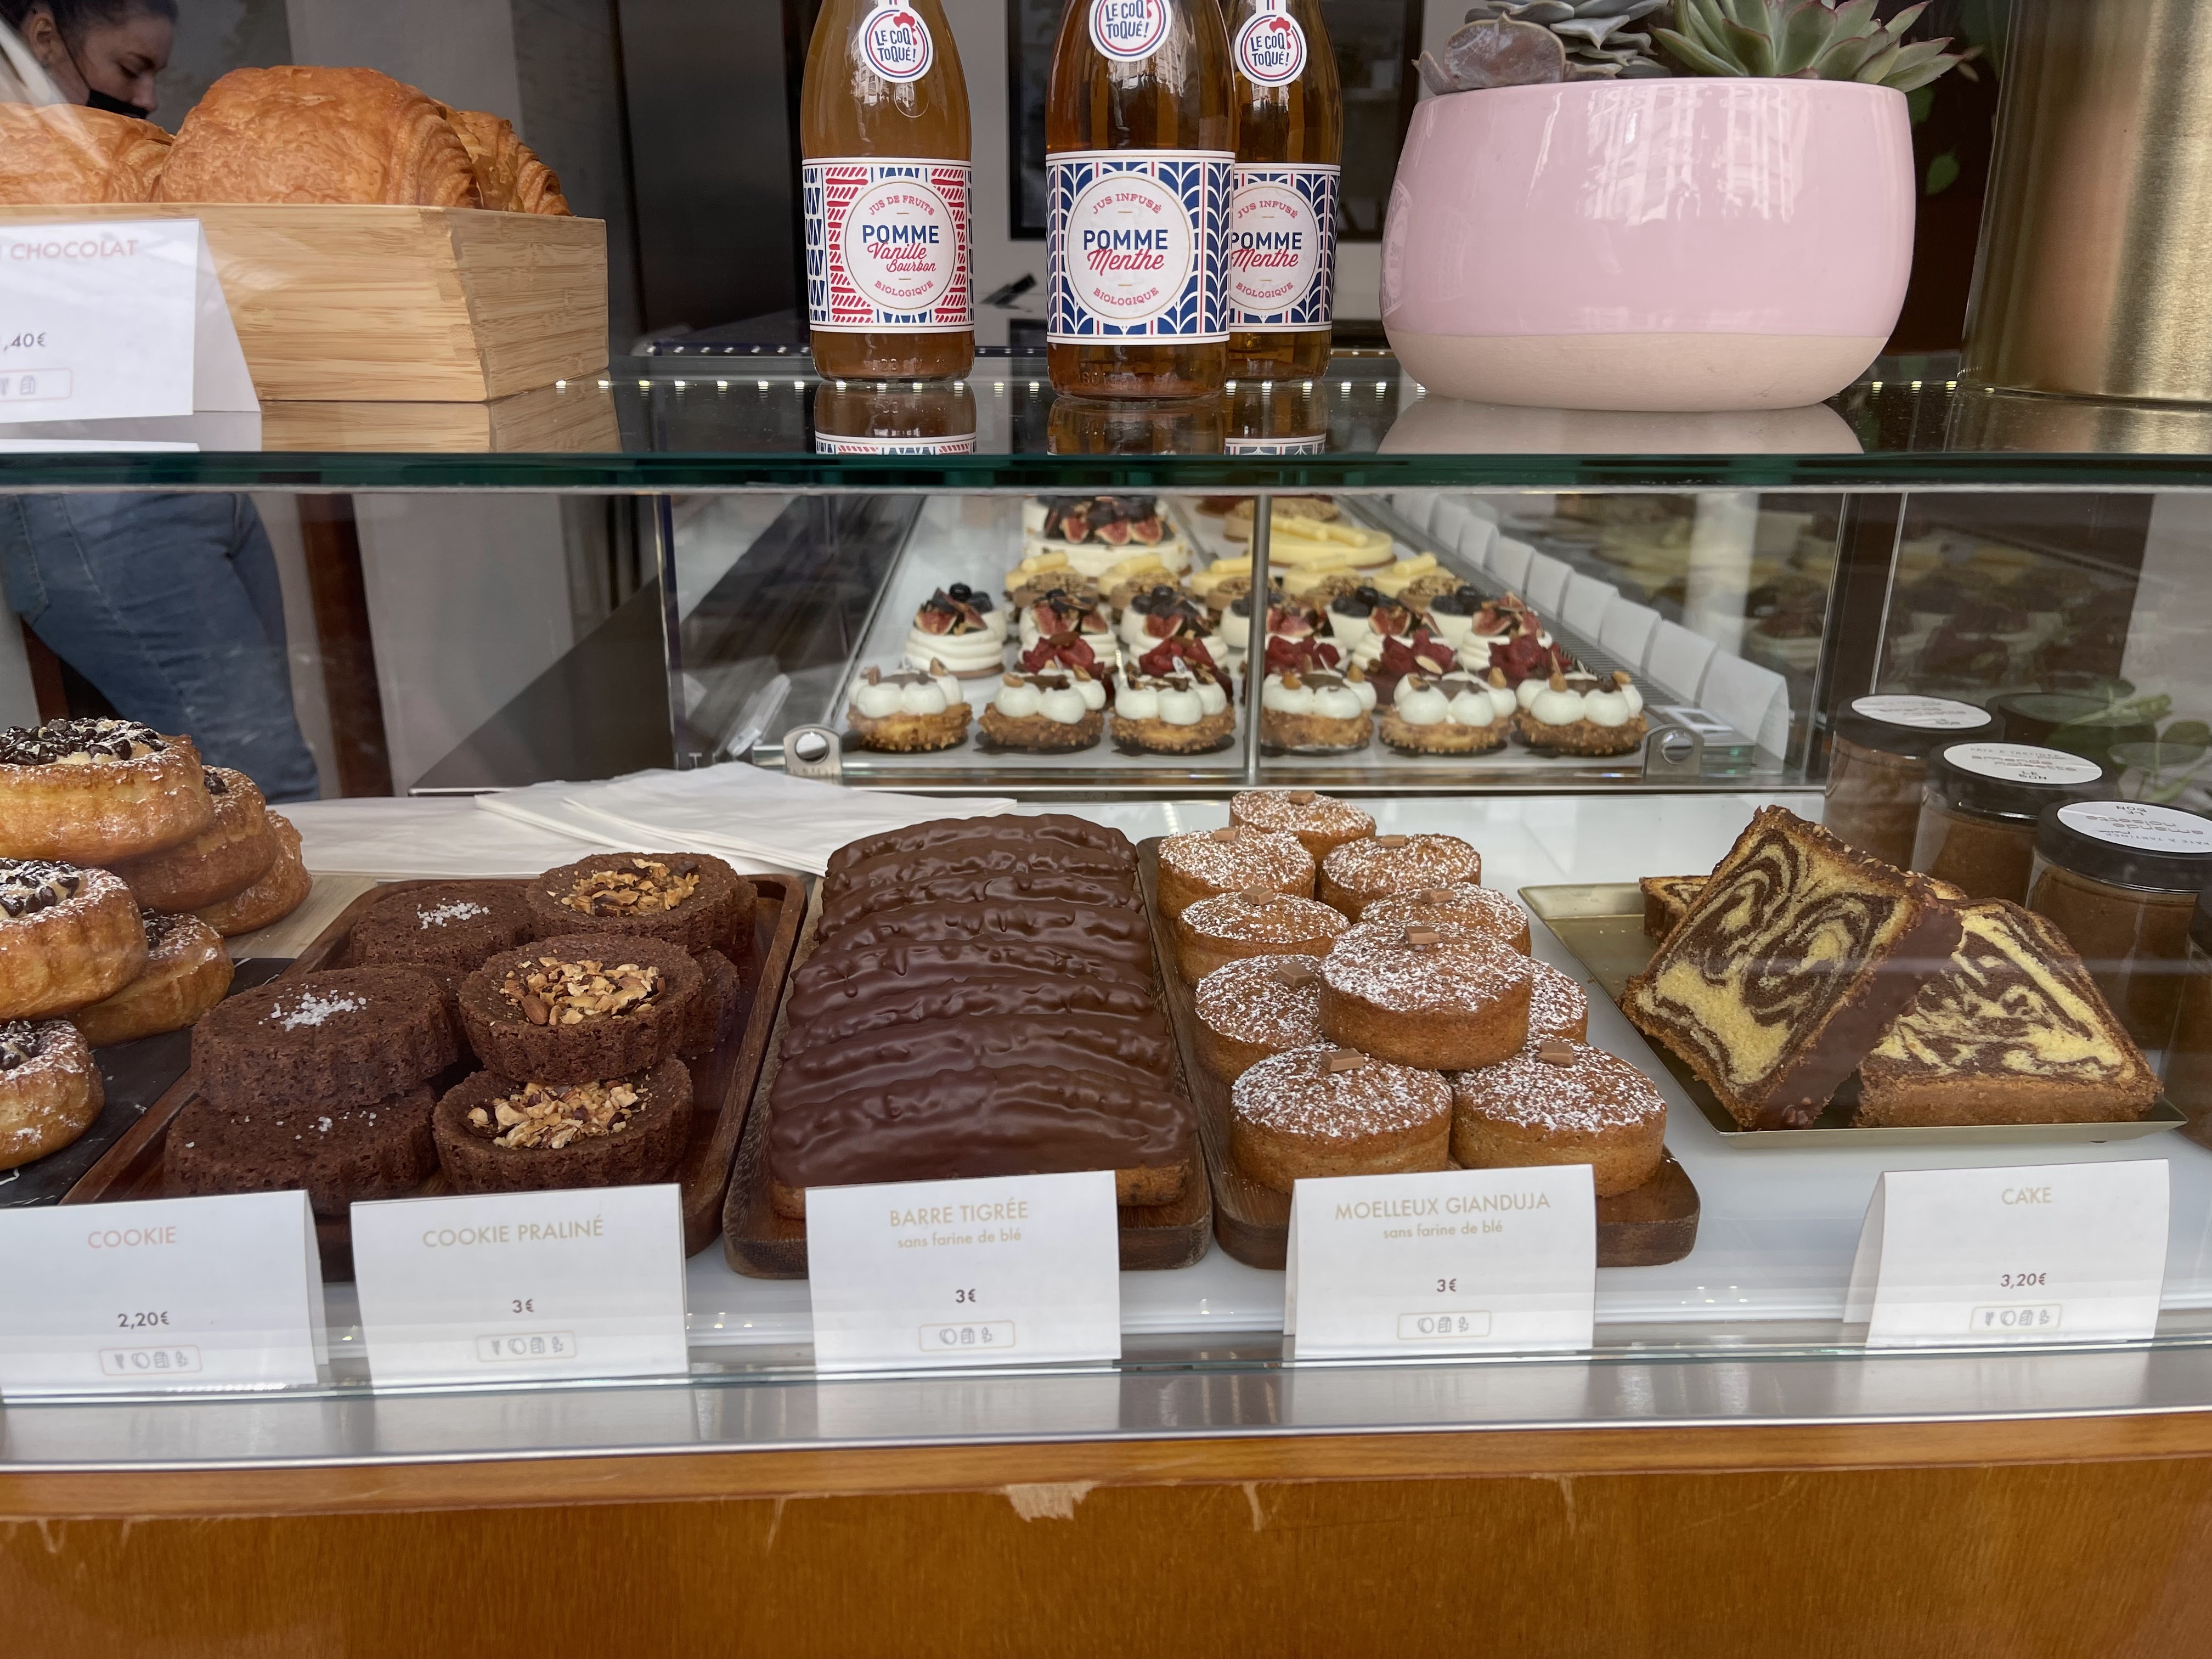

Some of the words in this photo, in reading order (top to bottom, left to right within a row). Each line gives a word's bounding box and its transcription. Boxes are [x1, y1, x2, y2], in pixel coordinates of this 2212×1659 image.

[1105, 3, 1118, 21] LE
[1121, 0, 1144, 19] COQ
[874, 30, 887, 46] LE
[890, 27, 911, 46] COQ
[1250, 36, 1262, 52] LE
[1265, 32, 1285, 49] COQ
[868, 200, 885, 215] JUS
[888, 195, 899, 205] DE
[902, 195, 935, 216] FRUITS
[1092, 195, 1113, 215] JUS
[1116, 193, 1163, 215] INFUSÉ
[1237, 202, 1256, 219] JUS
[1260, 200, 1298, 219] INFUSÉ
[862, 224, 939, 244] POMME
[1084, 229, 1169, 251] POMME
[1232, 232, 1302, 250] POMME
[10, 239, 138, 261] CHOCOLAT
[867, 241, 927, 259] Vanille
[886, 259, 936, 272] Bourbon
[1087, 249, 1164, 276] Menthe
[1231, 249, 1299, 272] Menthe
[874, 280, 934, 297] BIOLOGIQUE
[1092, 287, 1159, 306] BIOLOGIQUE
[1235, 282, 1294, 298] BIOLOGIQUE
[1, 332, 47, 352] ,40€
[2086, 816, 2177, 827] noisette
[2113, 823, 2204, 835] amande
[2106, 833, 2163, 842] TARTINER
[2001, 1187, 2052, 1205] CAKE
[889, 1206, 953, 1227] BARRE
[960, 1198, 1029, 1222] TIGRÉE
[1335, 1198, 1440, 1220] MOELLEUX
[1446, 1192, 1551, 1214] GIANDUJA
[87, 1226, 176, 1249] COOKIE
[422, 1225, 509, 1248] COOKIE
[518, 1215, 603, 1242] PRALINÉ
[898, 1237, 928, 1249] sans
[932, 1233, 973, 1246] farine
[978, 1229, 995, 1243] de
[1000, 1227, 1022, 1242] blé
[1384, 1227, 1413, 1239] sans
[1417, 1223, 1456, 1237] farine
[1461, 1221, 1478, 1235] de
[1482, 1220, 1503, 1234] blé
[2000, 1272, 2047, 1289] 3,20€
[117, 1311, 170, 1329] 2,20€
